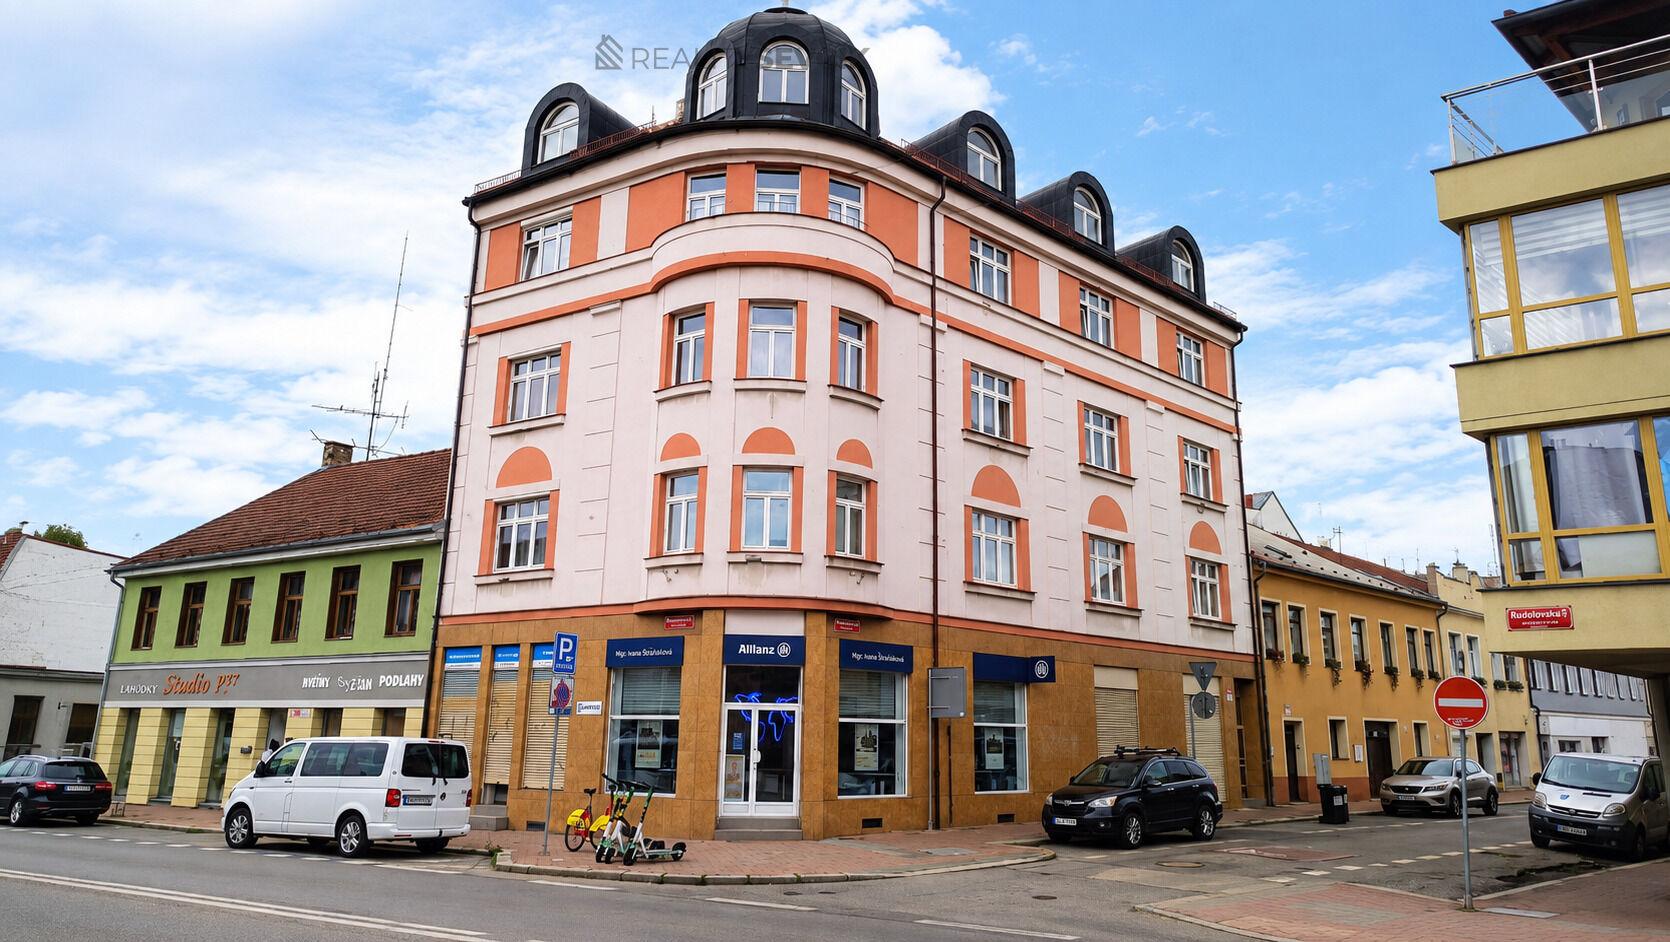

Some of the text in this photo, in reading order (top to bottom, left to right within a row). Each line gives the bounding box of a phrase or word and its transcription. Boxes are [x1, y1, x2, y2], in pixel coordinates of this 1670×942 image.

[559, 637, 574, 660] P
[738, 643, 775, 655] Allianz
[163, 672, 210, 695] Studio
[379, 674, 425, 687] PODLAHY
